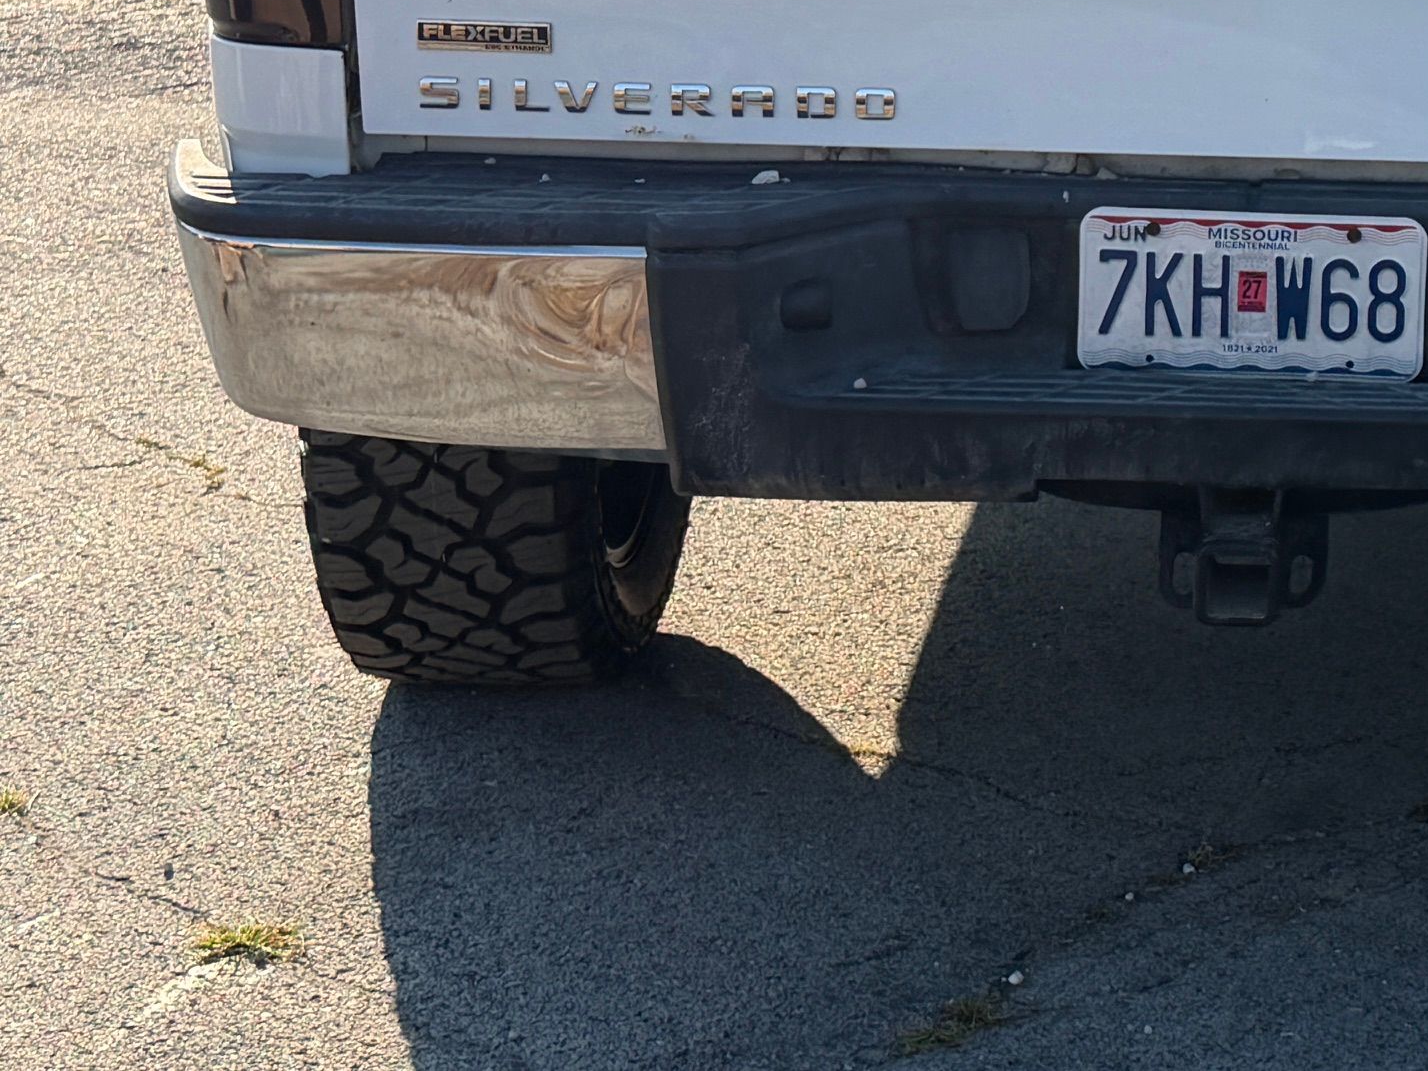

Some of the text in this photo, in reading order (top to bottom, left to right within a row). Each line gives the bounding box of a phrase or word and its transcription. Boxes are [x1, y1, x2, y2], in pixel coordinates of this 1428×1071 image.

[423, 24, 545, 44] FLEXFUEL
[419, 75, 897, 121] SILVERADO
[1103, 224, 1148, 242] JUN
[1207, 227, 1298, 244] MISSOURI
[1214, 241, 1290, 251] BICENTENNIAL
[1242, 279, 1262, 299] 27
